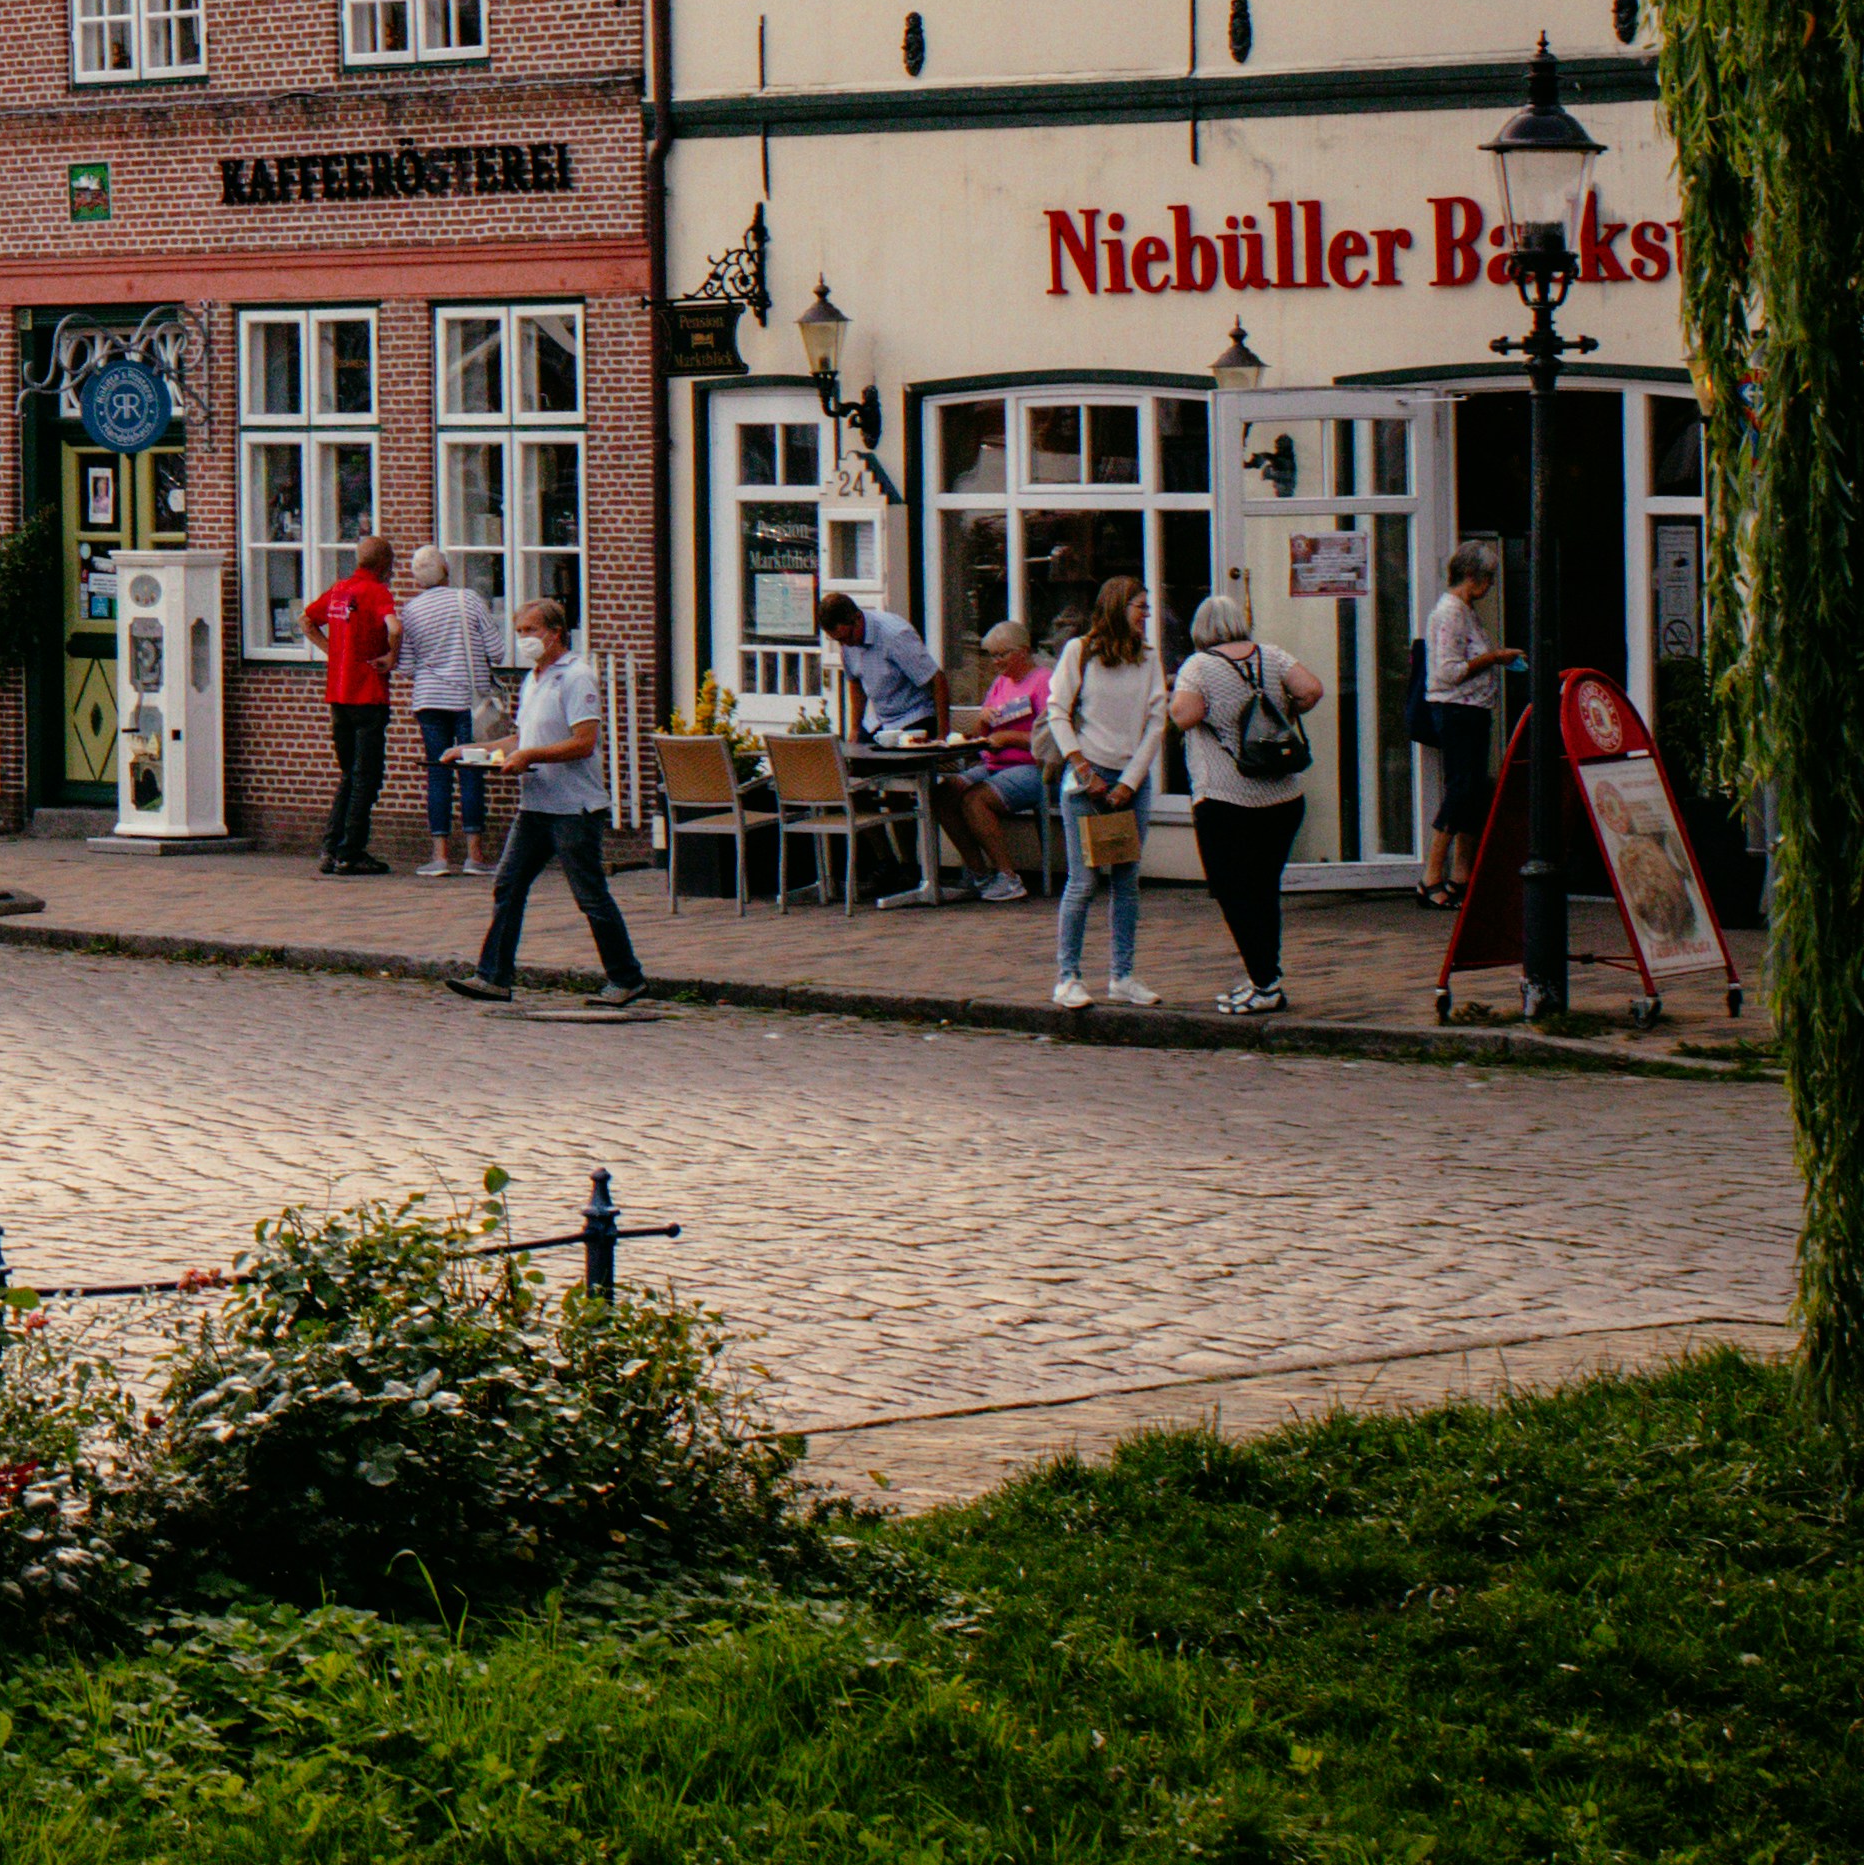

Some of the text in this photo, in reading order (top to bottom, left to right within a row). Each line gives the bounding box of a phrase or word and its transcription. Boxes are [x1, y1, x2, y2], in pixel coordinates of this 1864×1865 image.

[219, 137, 573, 205] KAFFEERÖSTEREI
[1043, 199, 1412, 296] Niebüller
[838, 471, 865, 497] 24
[749, 549, 818, 570] Marktblick
